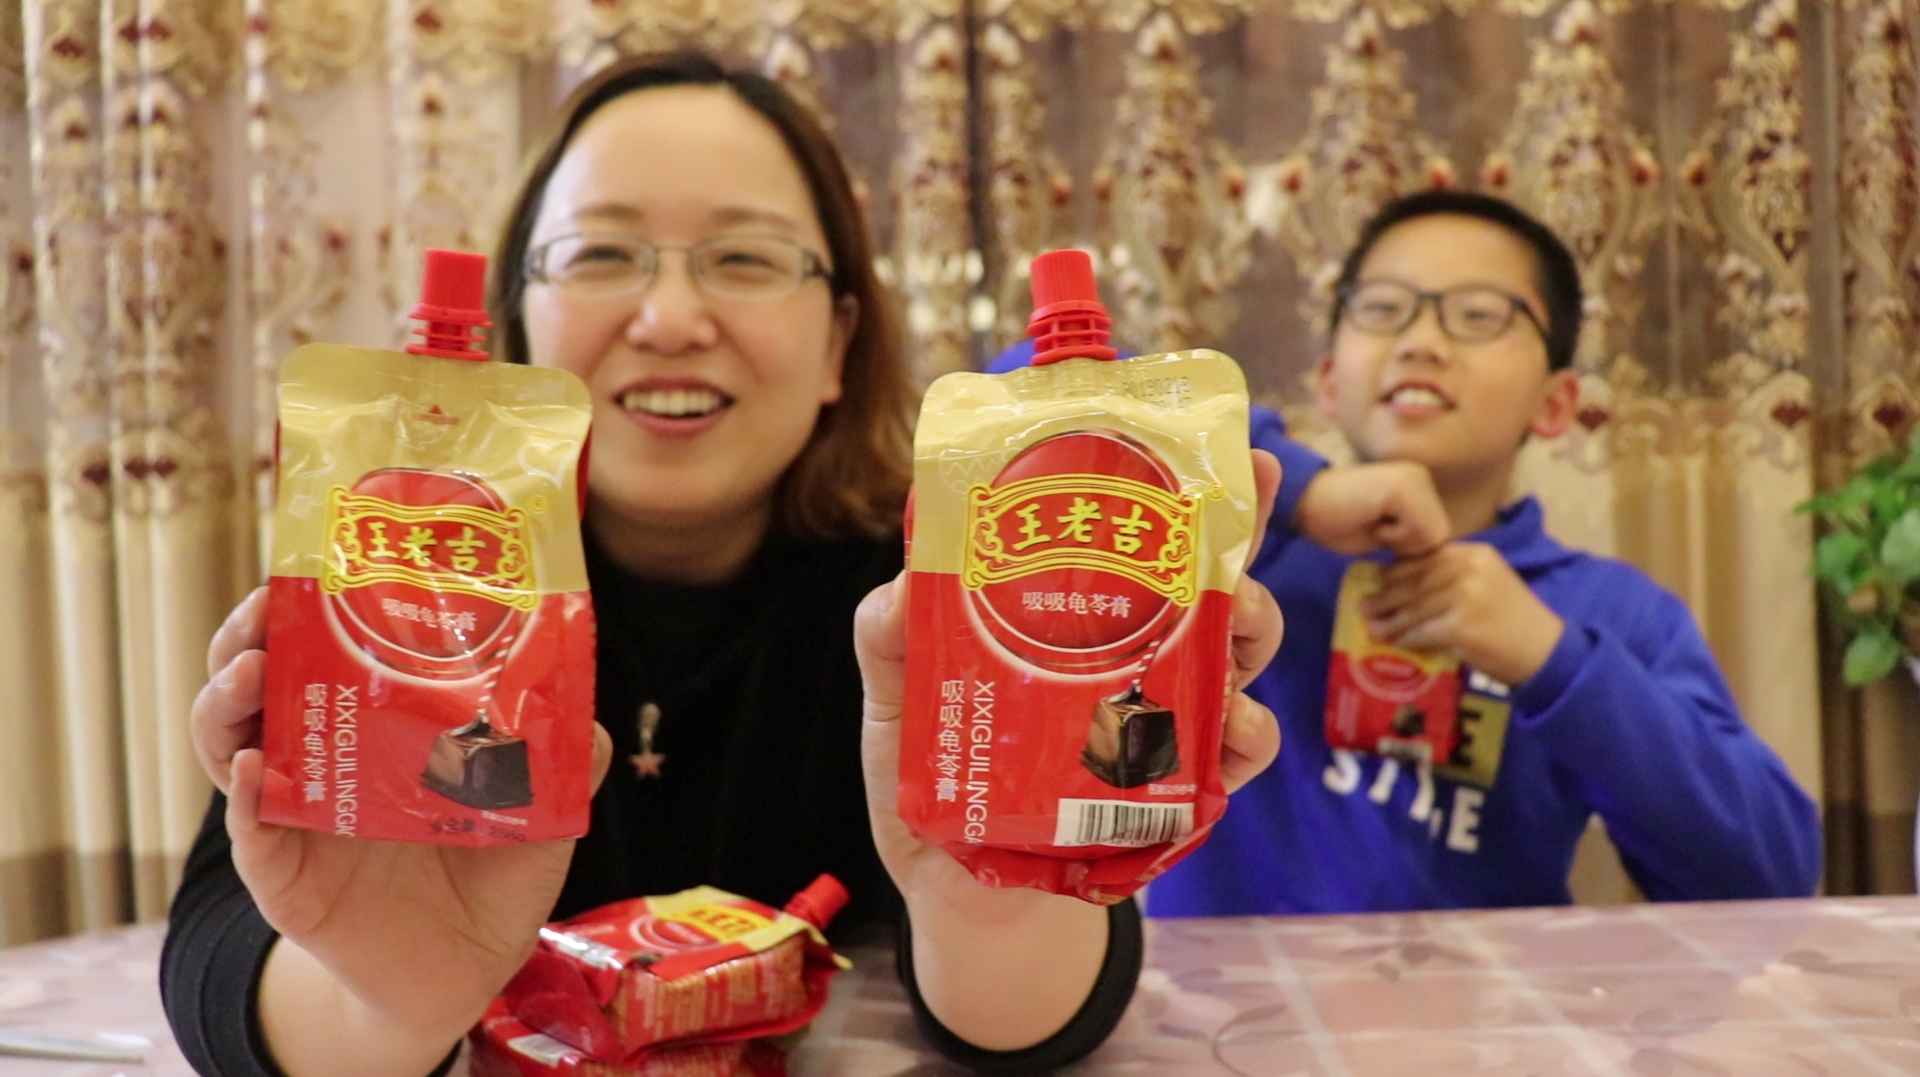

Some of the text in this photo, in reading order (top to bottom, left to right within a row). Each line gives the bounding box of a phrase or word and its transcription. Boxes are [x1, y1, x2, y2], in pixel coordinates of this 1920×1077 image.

[366, 521, 486, 572] 王老吉
[1012, 498, 1152, 554] 王老吉
[1022, 592, 1131, 617] 吸吸龟苓膏
[302, 683, 328, 803] 吸吸龟苓膏
[935, 680, 965, 802] 吸吸龟苓膏
